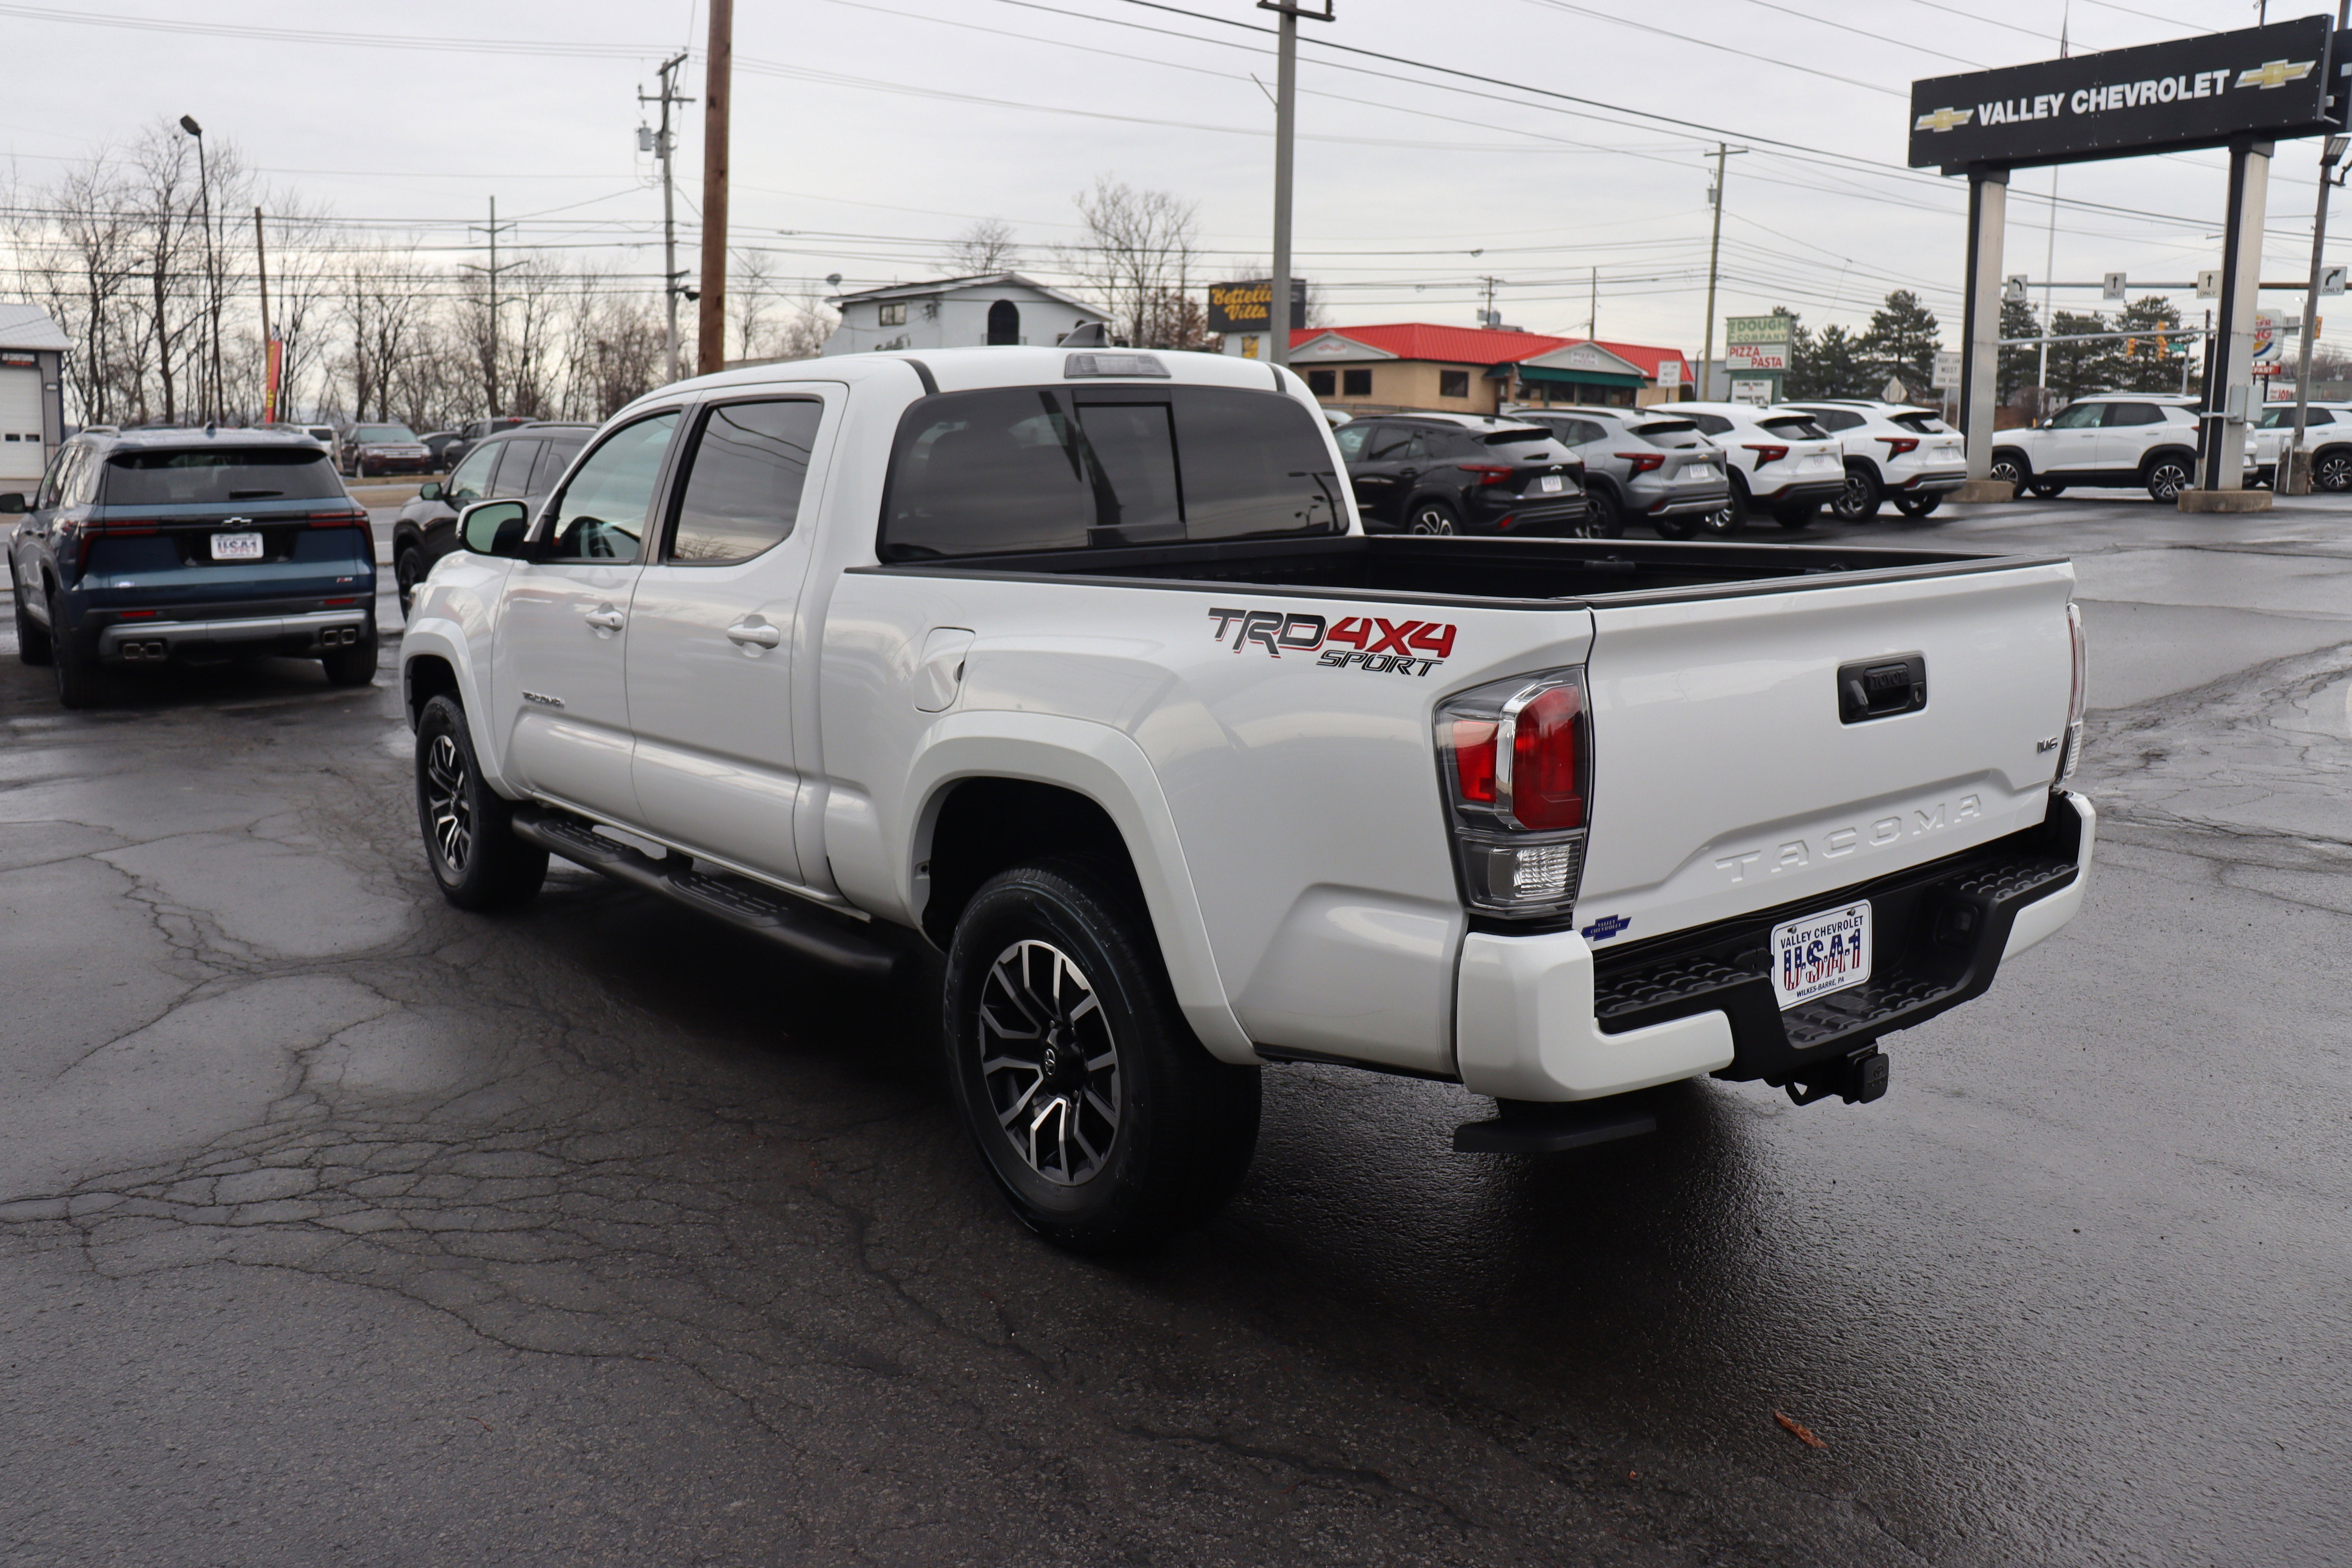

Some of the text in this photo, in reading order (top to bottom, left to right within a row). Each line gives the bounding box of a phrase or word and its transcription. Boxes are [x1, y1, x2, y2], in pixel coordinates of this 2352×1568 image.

[1978, 69, 2230, 127] VALLEY CHEVROLET
[1224, 305, 1268, 320] Villa
[1738, 320, 1787, 331] DOUGH
[1737, 334, 1786, 342] COMPANY
[1730, 346, 1760, 357] PIZZA
[1751, 357, 1782, 367] PASTA
[1208, 607, 1327, 659] TRD
[1316, 650, 1444, 677] SPORT
[1871, 670, 1909, 688] TOYOTA
[2038, 737, 2058, 753] V6
[1715, 794, 1981, 882] TACOMA
[1590, 923, 1621, 934] CHEVROLET
[1597, 919, 1616, 927] VALLEY
[1781, 915, 1864, 949] VALLEY CHEVROLET
[1797, 980, 1836, 998] WILKES-BARRE,
